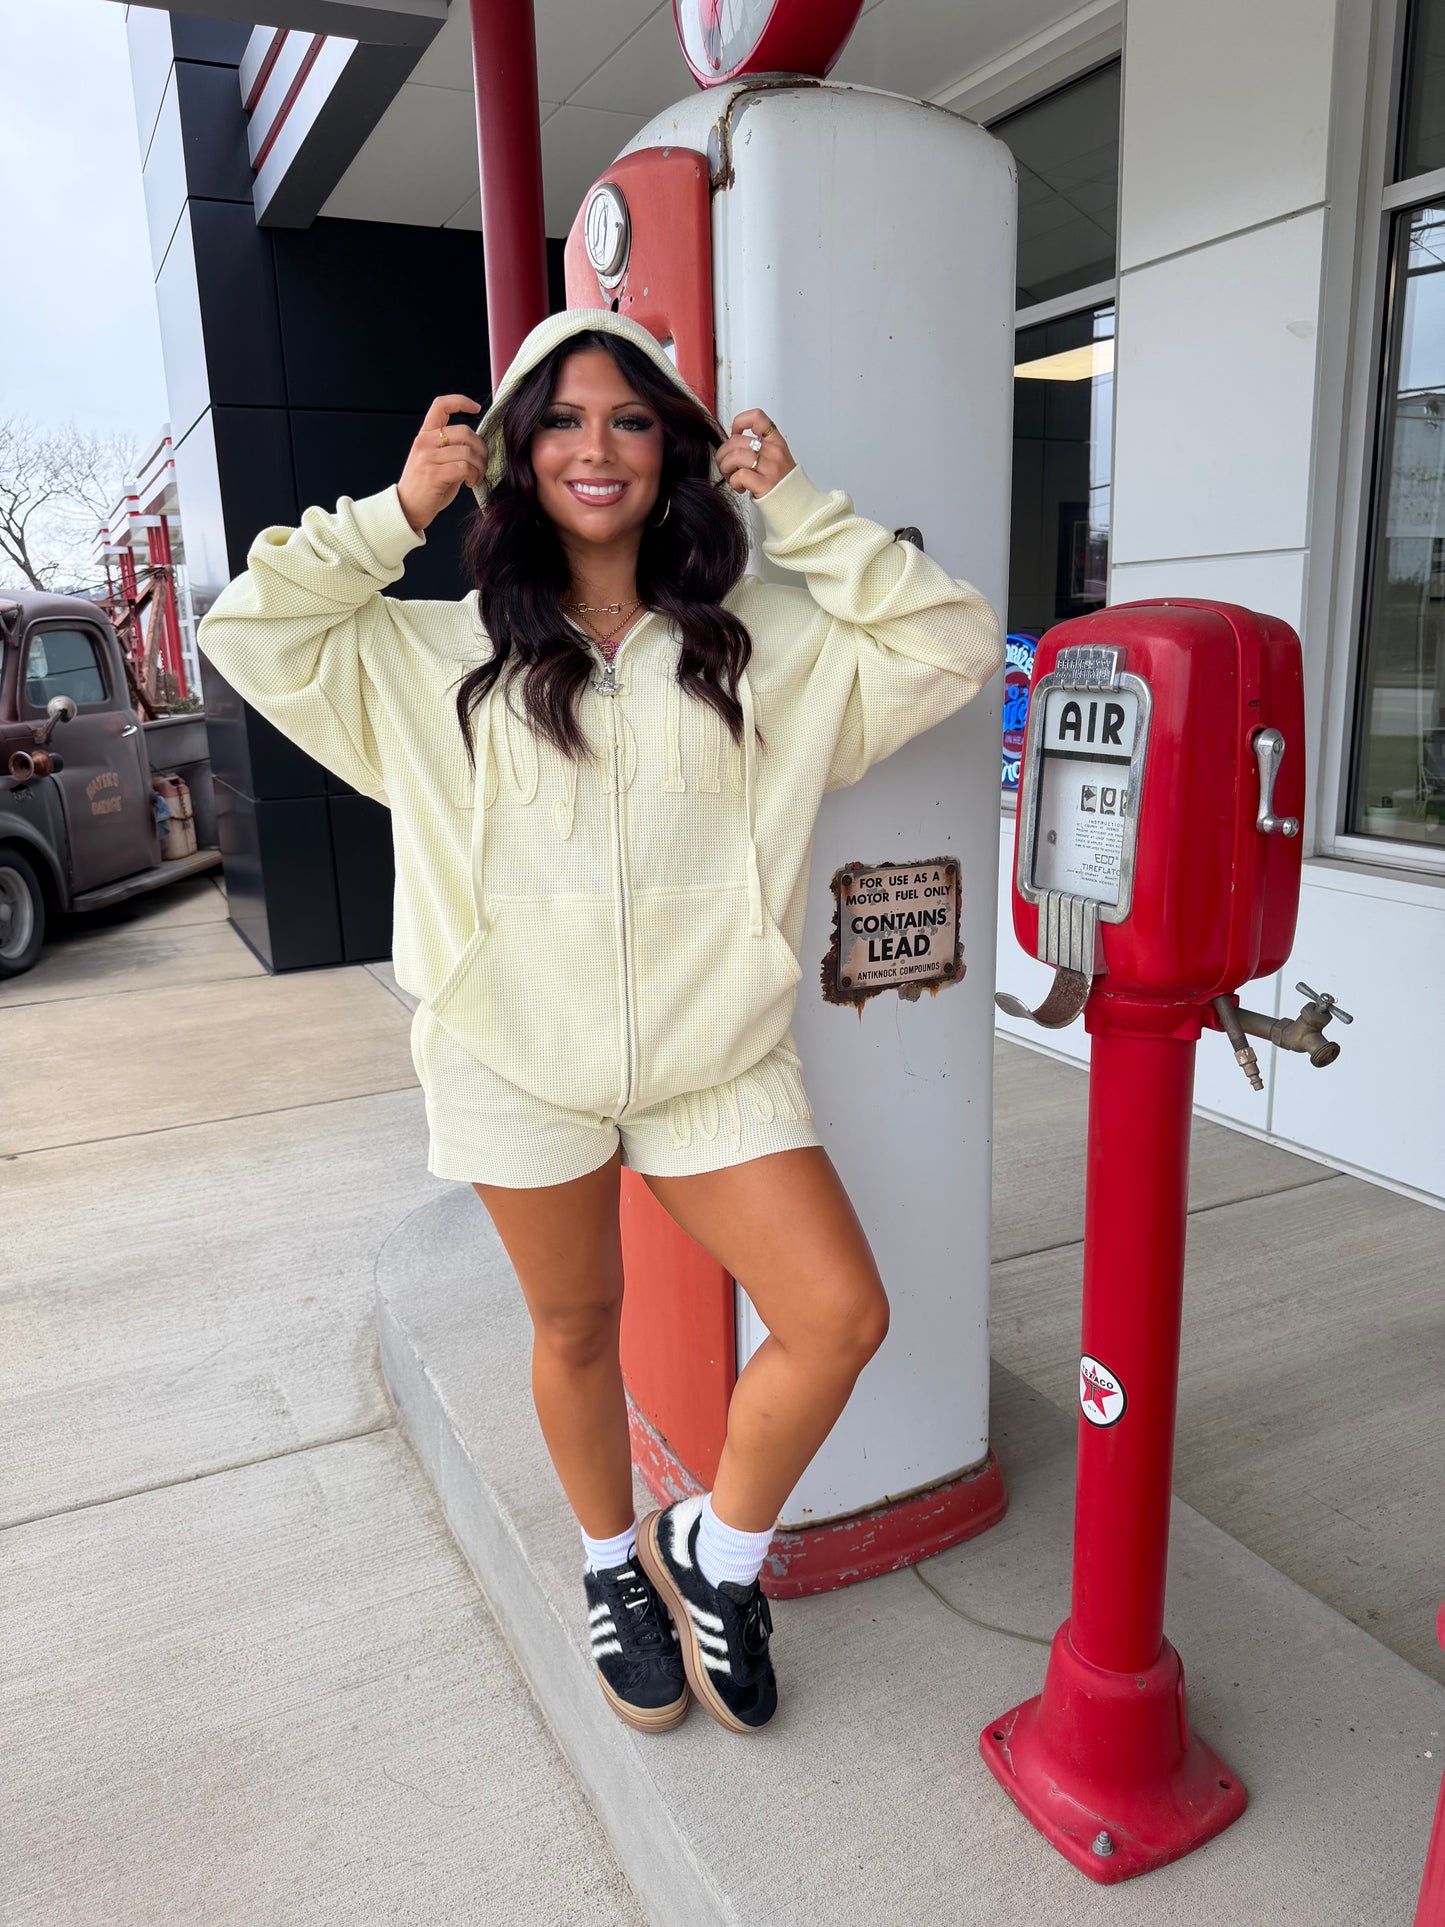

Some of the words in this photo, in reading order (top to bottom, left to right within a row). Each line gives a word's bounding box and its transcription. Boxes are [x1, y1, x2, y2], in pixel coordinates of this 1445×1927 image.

[1059, 701, 1125, 745] AIR
[860, 878, 882, 889] FOR
[889, 875, 909, 886] USE
[914, 873, 927, 884] AS
[932, 871, 940, 881] A
[846, 892, 889, 906] MOTOR
[895, 889, 918, 901] FUEL
[924, 885, 952, 898] ONLY
[851, 908, 947, 934] CONTAINS
[868, 934, 930, 963] LEAD
[857, 968, 897, 981] ANTIKNOCK
[900, 962, 940, 976] COMPOUNDS
[1081, 1364, 1114, 1390] TEXACO
